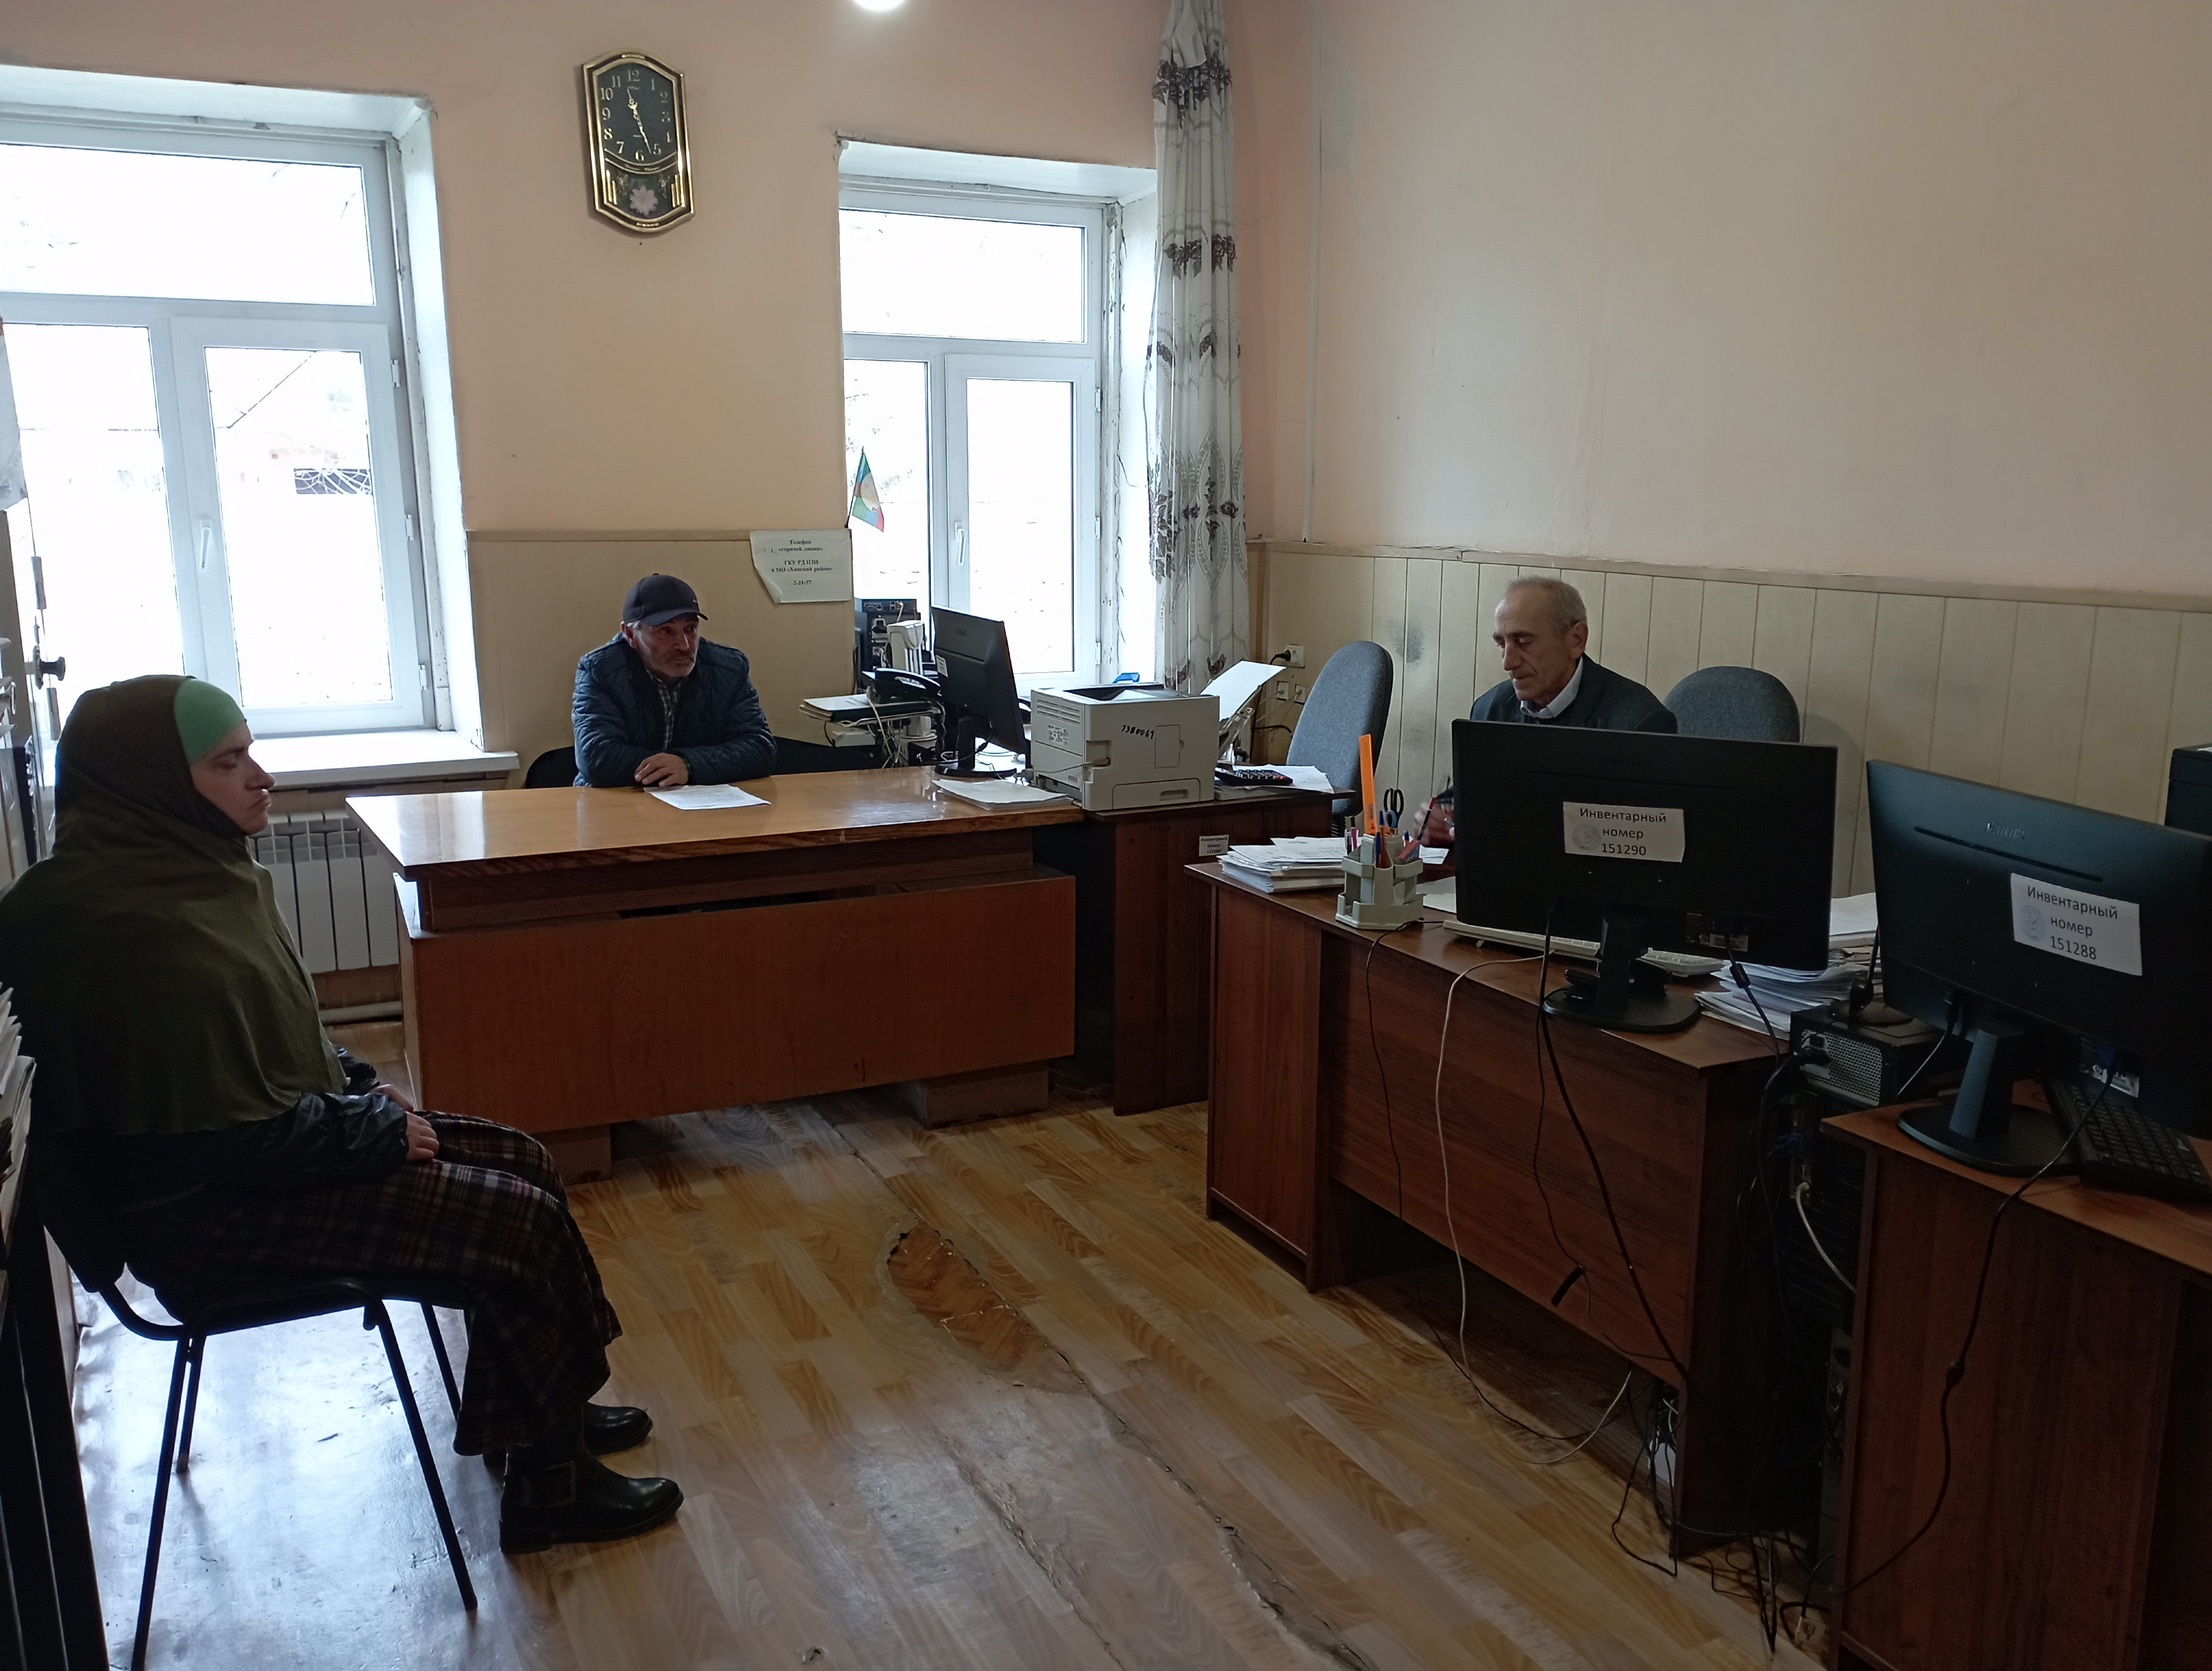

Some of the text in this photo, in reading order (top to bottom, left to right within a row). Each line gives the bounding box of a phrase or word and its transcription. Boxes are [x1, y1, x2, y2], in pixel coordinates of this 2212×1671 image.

[610, 75, 621, 87] 11
[627, 70, 640, 82] 12
[651, 78, 654, 91] 1
[601, 88, 613, 101] 10
[660, 92, 668, 103] 2
[602, 108, 610, 120] 9
[662, 112, 670, 122] 3
[604, 128, 613, 140] 8
[616, 140, 625, 154] 7
[653, 143, 661, 155] 5
[635, 150, 644, 162] 6
[1580, 808, 1667, 824] Инвентарный
[1603, 828, 1644, 841] номер
[1602, 843, 1647, 856] 151290
[2028, 886, 2118, 920] Инвентарный
[2050, 917, 2093, 938] номер
[2050, 936, 2097, 960] 151288
